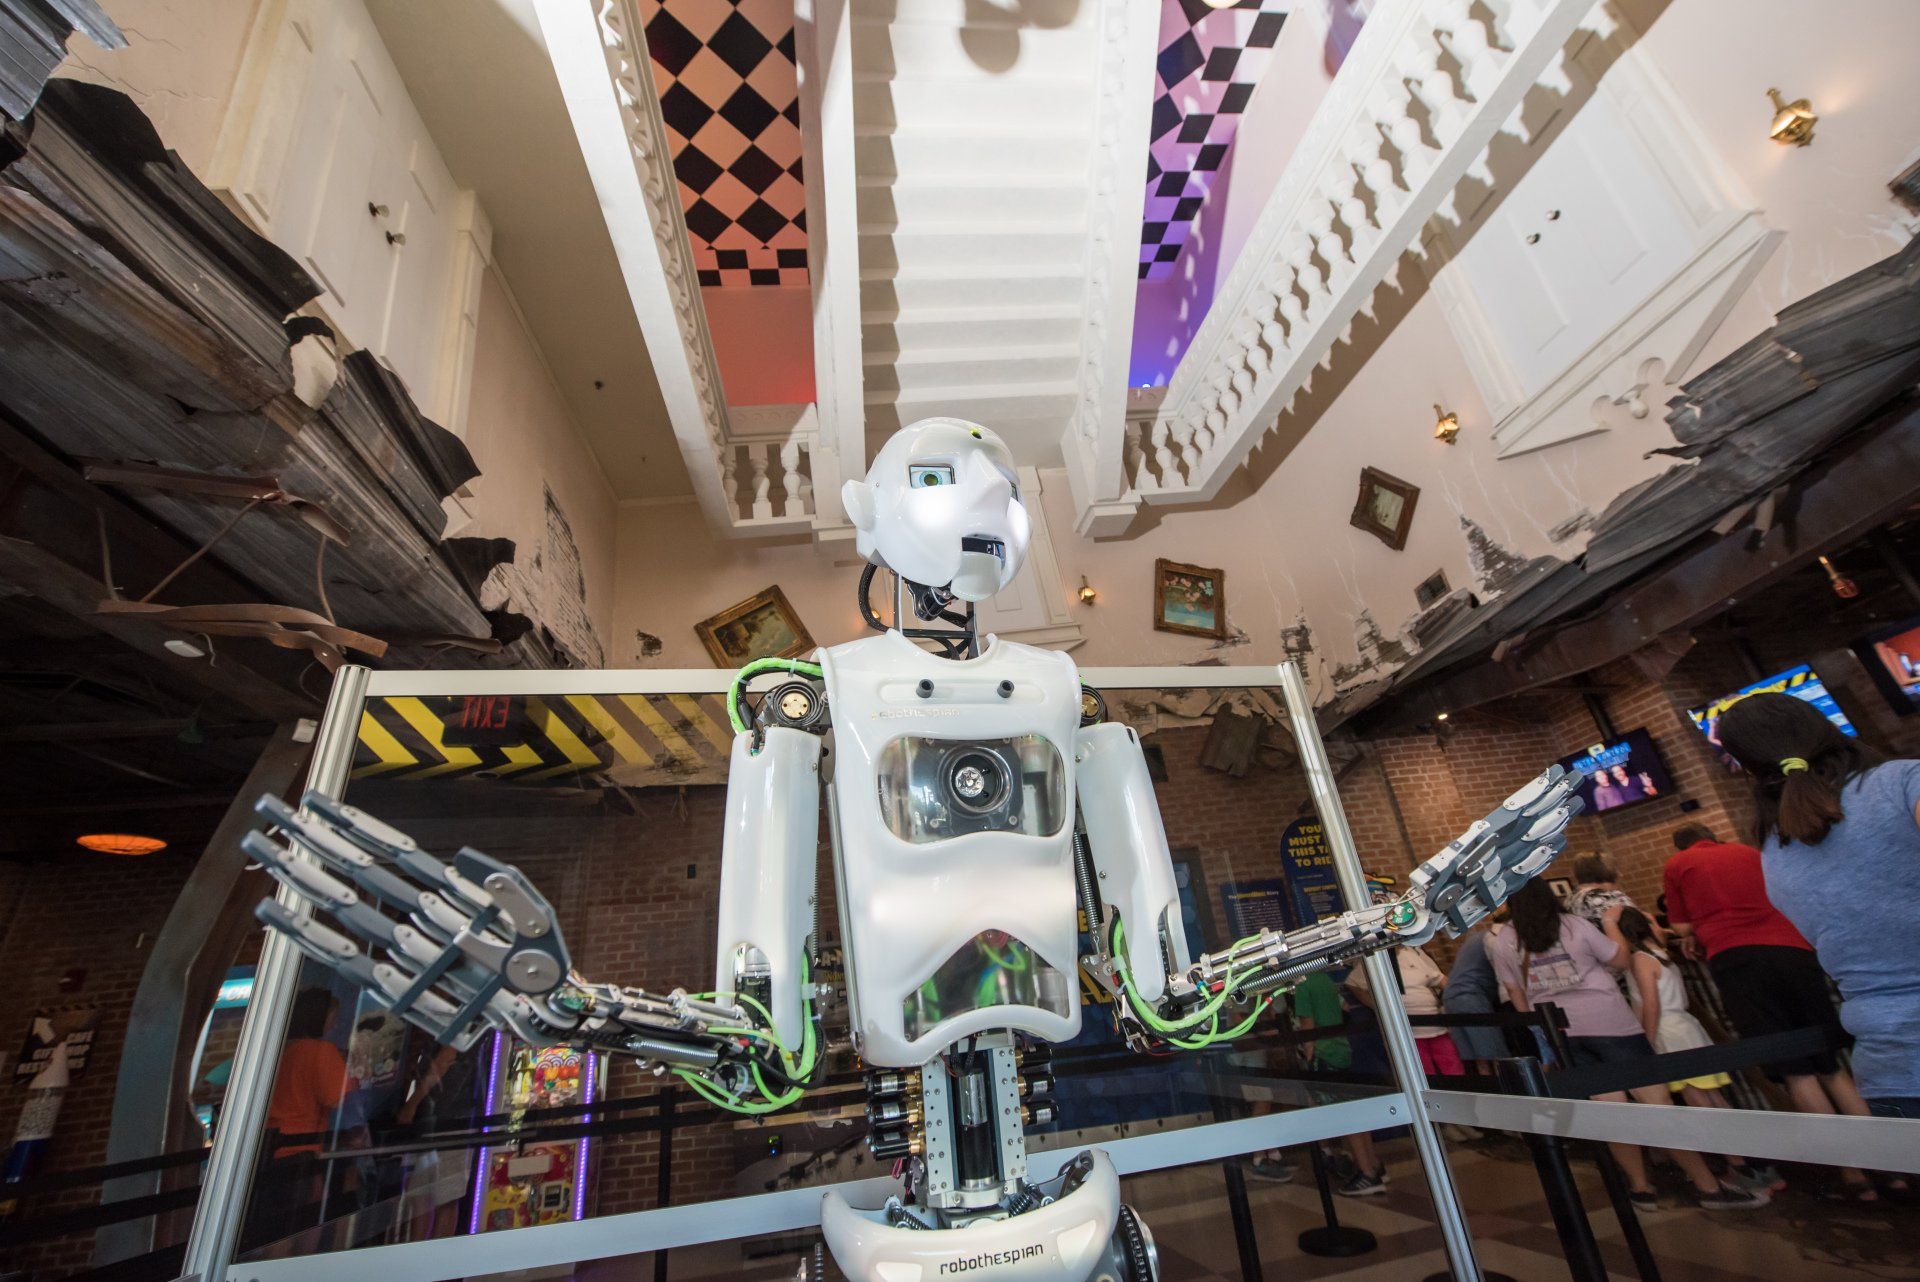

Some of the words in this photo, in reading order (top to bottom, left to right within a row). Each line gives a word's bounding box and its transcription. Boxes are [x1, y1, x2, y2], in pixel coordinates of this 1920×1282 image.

[1299, 825, 1322, 835] YOU
[1289, 836, 1320, 847] MUST
[1288, 847, 1315, 857] THIS
[1296, 858, 1311, 867] TO
